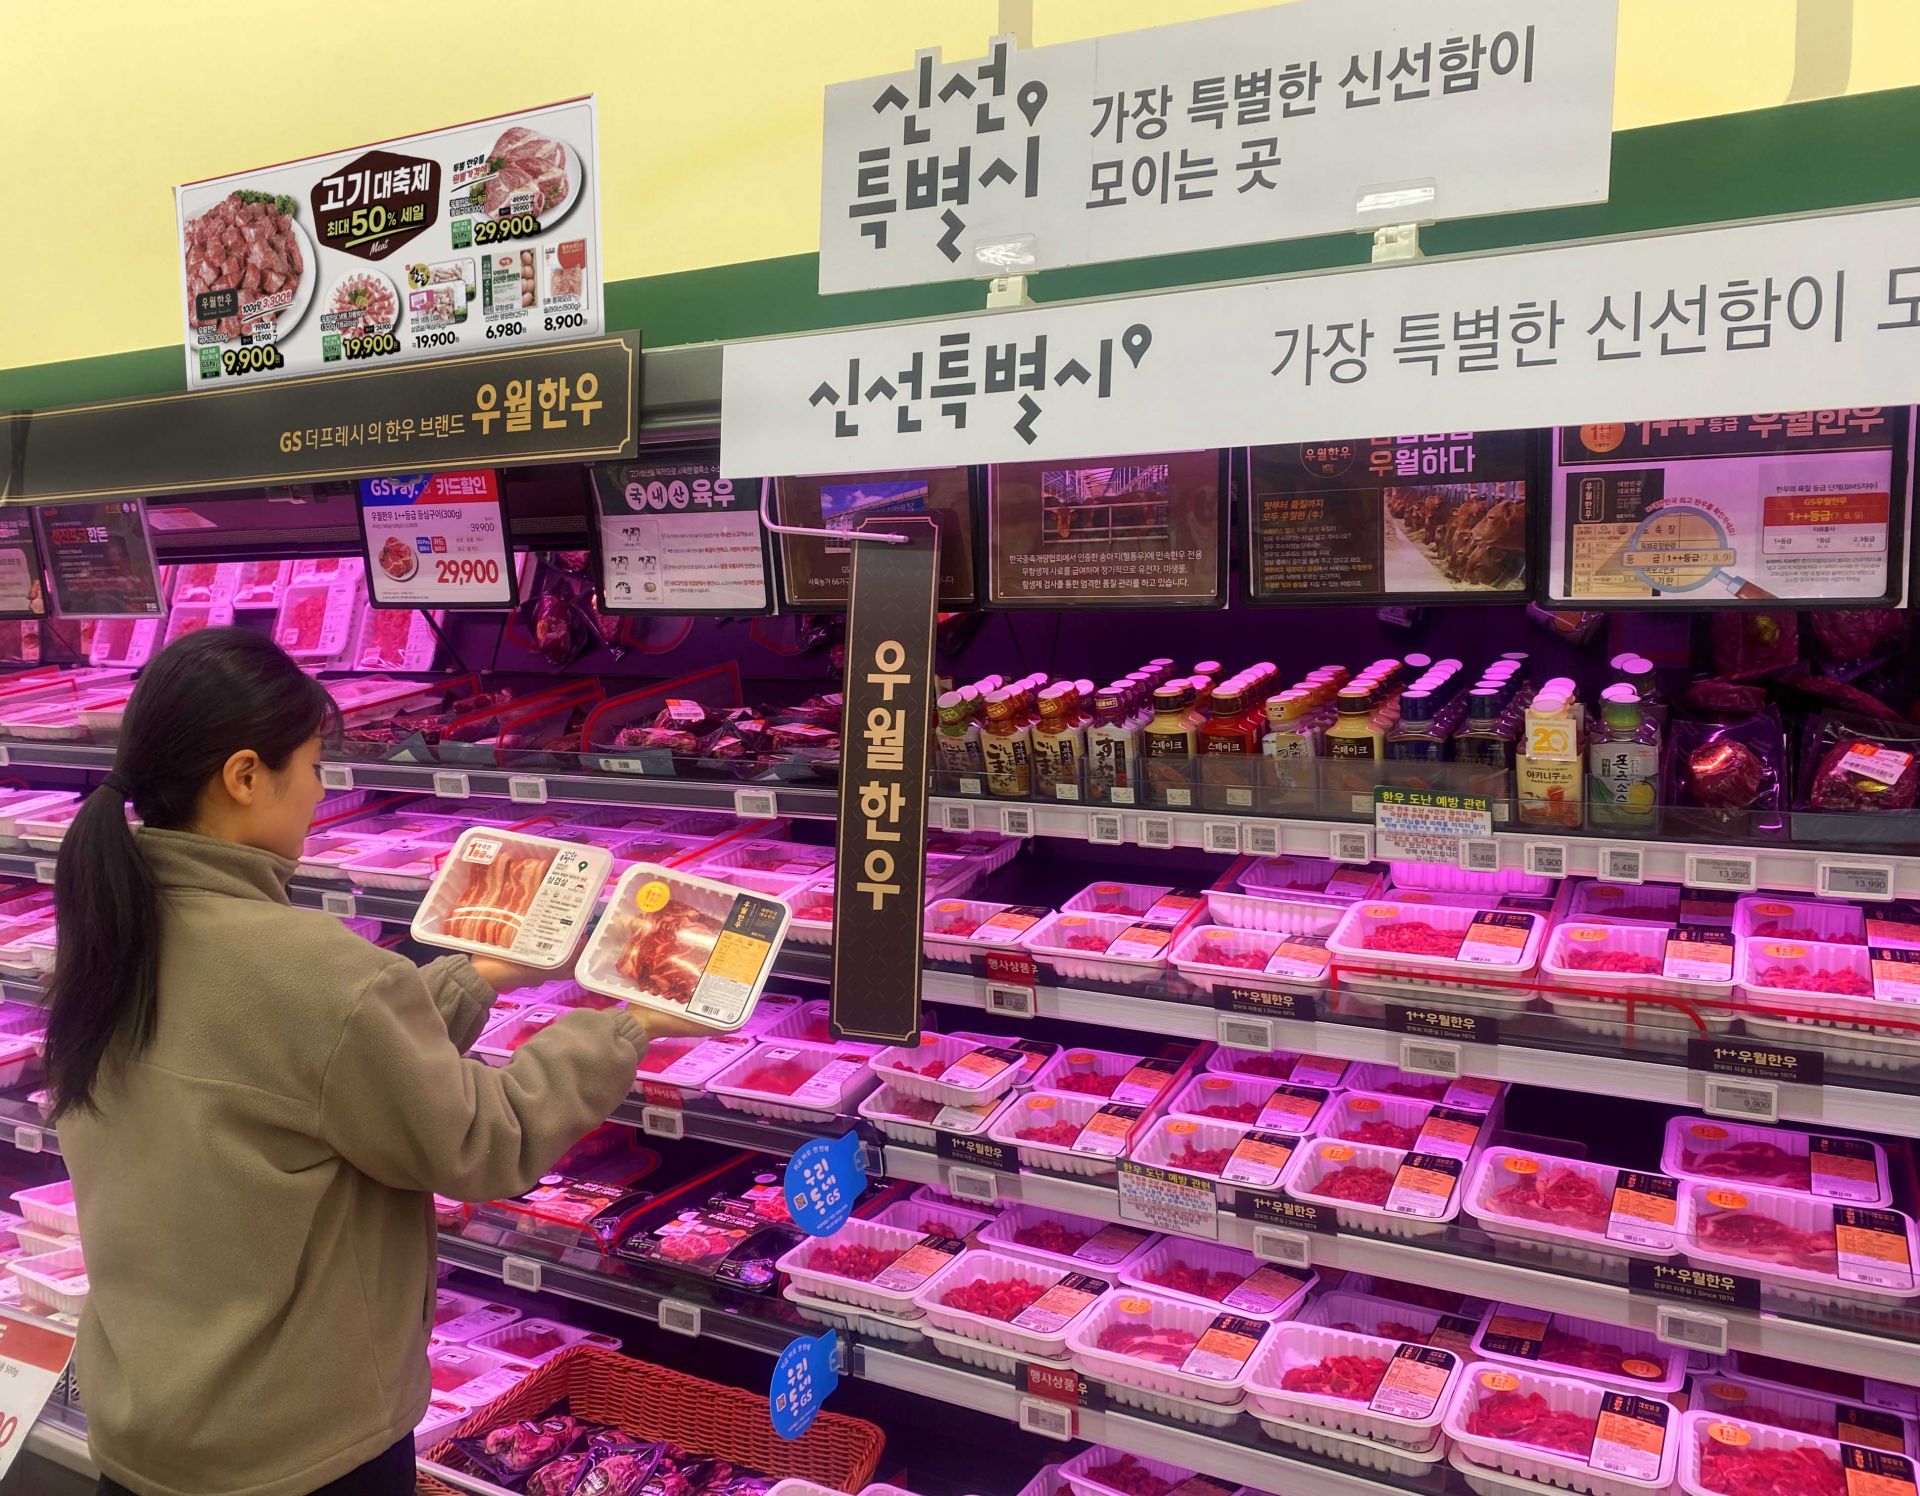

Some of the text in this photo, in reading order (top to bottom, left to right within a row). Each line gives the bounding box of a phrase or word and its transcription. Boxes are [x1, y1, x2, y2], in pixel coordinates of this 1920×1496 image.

[872, 42, 1008, 145] 신선
[1089, 25, 1537, 144] 가장 특별한 신선함이
[1085, 136, 1283, 211] 모이는 곳
[848, 134, 1041, 264] 특별시
[351, 205, 397, 237] 50%
[401, 204, 425, 222] 세일
[370, 239, 389, 256] Meat
[201, 293, 233, 310] 우월한우
[808, 332, 1113, 445] 신선특별시
[1270, 318, 1374, 387] 가장
[1392, 299, 1566, 377] 특별한
[1586, 269, 1846, 362] 신선함이
[279, 431, 302, 453] GS
[385, 417, 416, 443] 한우
[419, 413, 466, 439] 브랜드
[471, 372, 603, 435] 우월한우
[1305, 445, 1476, 477] 우월한우 우월하다
[436, 475, 487, 496] 카드할인
[626, 479, 735, 508] 국내산 육우
[371, 511, 393, 522] 우월한우
[417, 508, 463, 521] 등심구이(300g)
[1187, 549, 1202, 560] 전용
[435, 559, 499, 586] 29,900
[1049, 566, 1071, 576] 사료를
[1101, 564, 1137, 575] 정기적으로
[1044, 579, 1064, 589] 검사를
[1065, 579, 1079, 589] 통한
[1080, 578, 1101, 589] 엄격한
[1102, 578, 1118, 589] 품질
[1118, 578, 1139, 588] 관리를
[1141, 578, 1156, 588] 하고
[1151, 740, 1183, 753] 스테이크
[1207, 741, 1241, 753] 스테이크
[1332, 744, 1369, 756] 스테이크
[856, 639, 912, 911] 우월한우
[1612, 754, 1630, 803] 폰즈소스
[1382, 791, 1486, 810] 한우 도난 예방 관련
[988, 958, 1030, 974] 행사상품
[1231, 989, 1295, 1007] 1++우월한우
[1406, 1010, 1476, 1030] 1++우월한우
[1713, 1047, 1798, 1069] 1++우월한우
[951, 1137, 1003, 1159] 1++우월한우
[803, 1158, 829, 1186] 우리
[1123, 1162, 1211, 1191] 한우 도난 예방 관련
[810, 1174, 837, 1215] 동네
[826, 1188, 841, 1206] GS
[1253, 1197, 1318, 1220] 1++우월한우
[1653, 1264, 1736, 1291] 1++우월한우
[787, 1357, 808, 1386] 우리
[1030, 1369, 1076, 1393] 행사상품
[788, 1374, 812, 1417] 동네
[800, 1388, 813, 1407] GS
